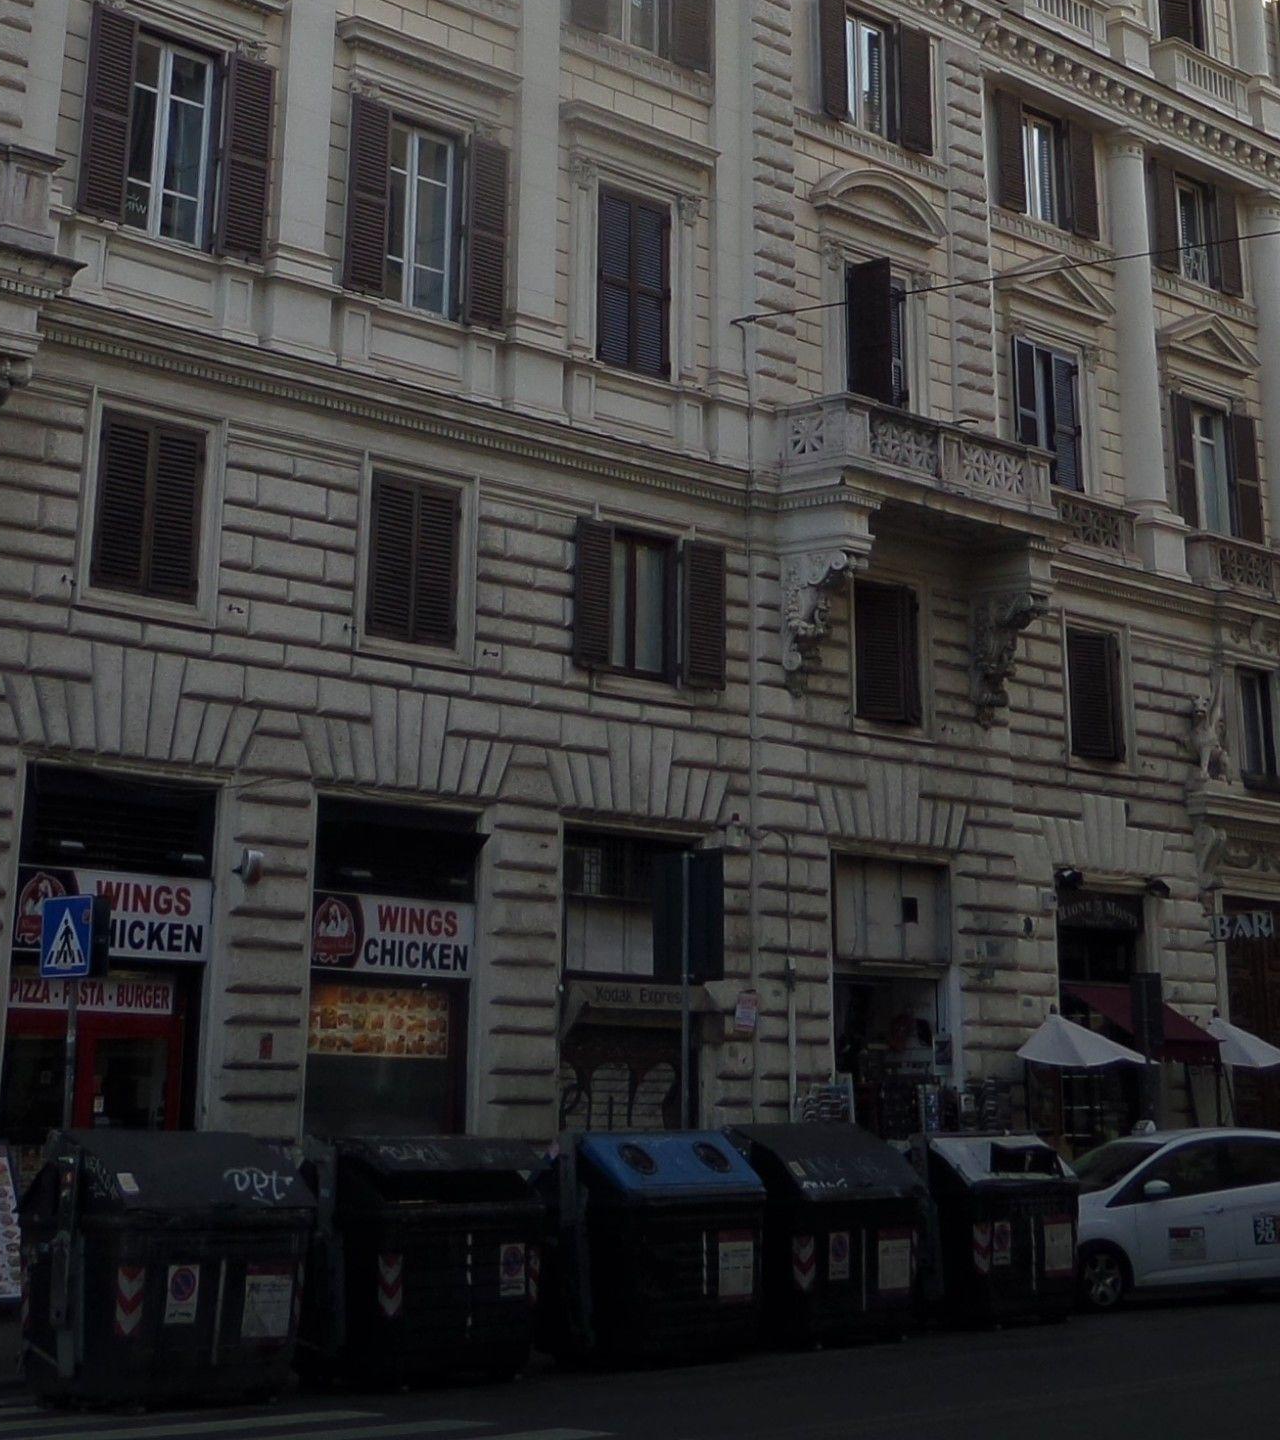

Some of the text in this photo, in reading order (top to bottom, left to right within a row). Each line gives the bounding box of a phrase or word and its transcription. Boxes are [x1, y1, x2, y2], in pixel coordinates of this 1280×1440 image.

[96, 880, 192, 917] WINGS
[377, 903, 458, 938] WINGS
[1208, 911, 1273, 940] BAR
[364, 937, 468, 972] CHICKEN
[9, 978, 170, 1009] PIZZA PSTA BURGER
[594, 985, 684, 1005] Kodak Expres
